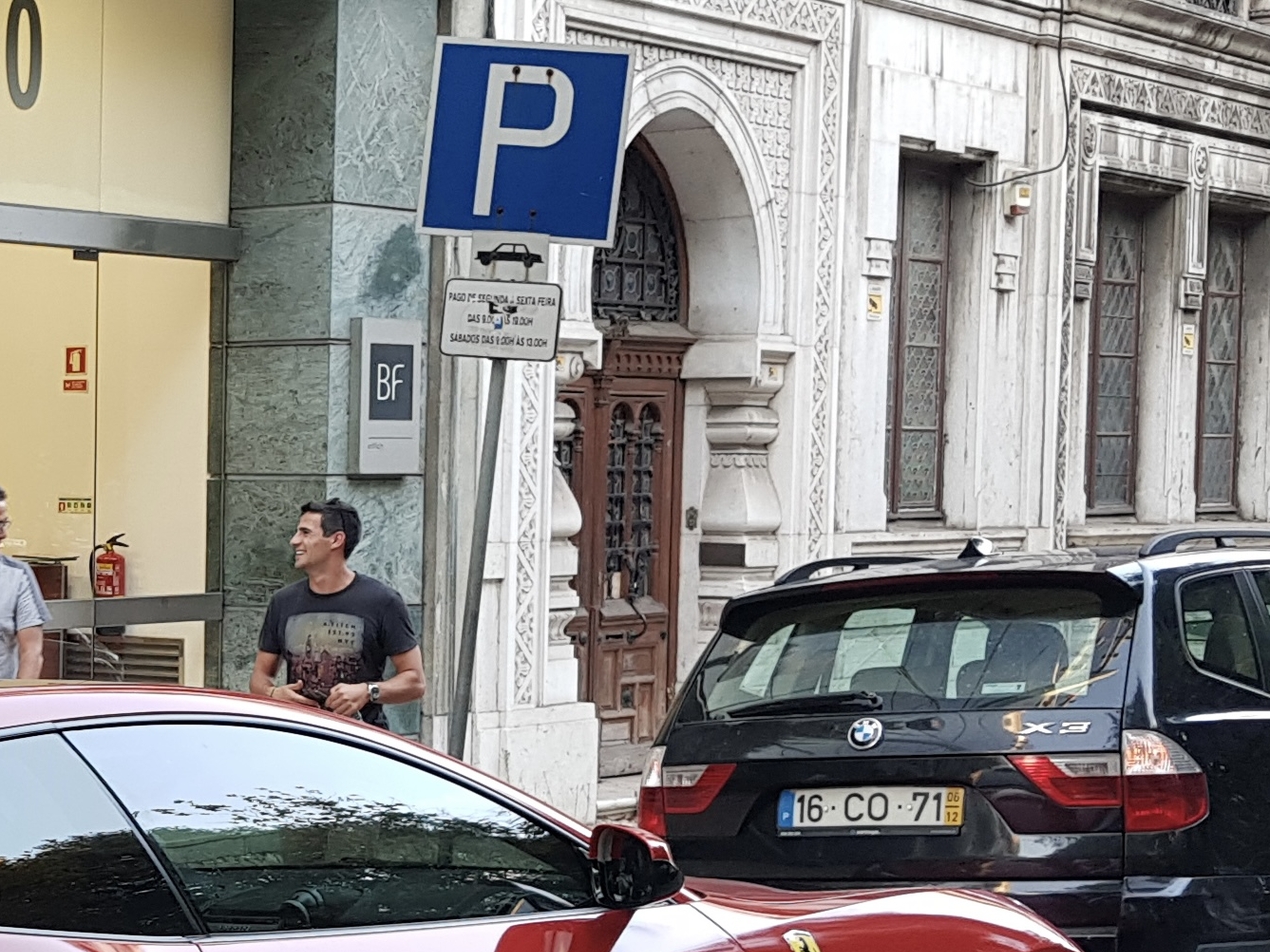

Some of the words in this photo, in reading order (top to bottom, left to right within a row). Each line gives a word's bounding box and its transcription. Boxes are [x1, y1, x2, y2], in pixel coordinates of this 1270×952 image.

[473, 63, 574, 216] P
[377, 363, 405, 401] BF
[1021, 721, 1091, 734] X3
[946, 811, 958, 822] 12
